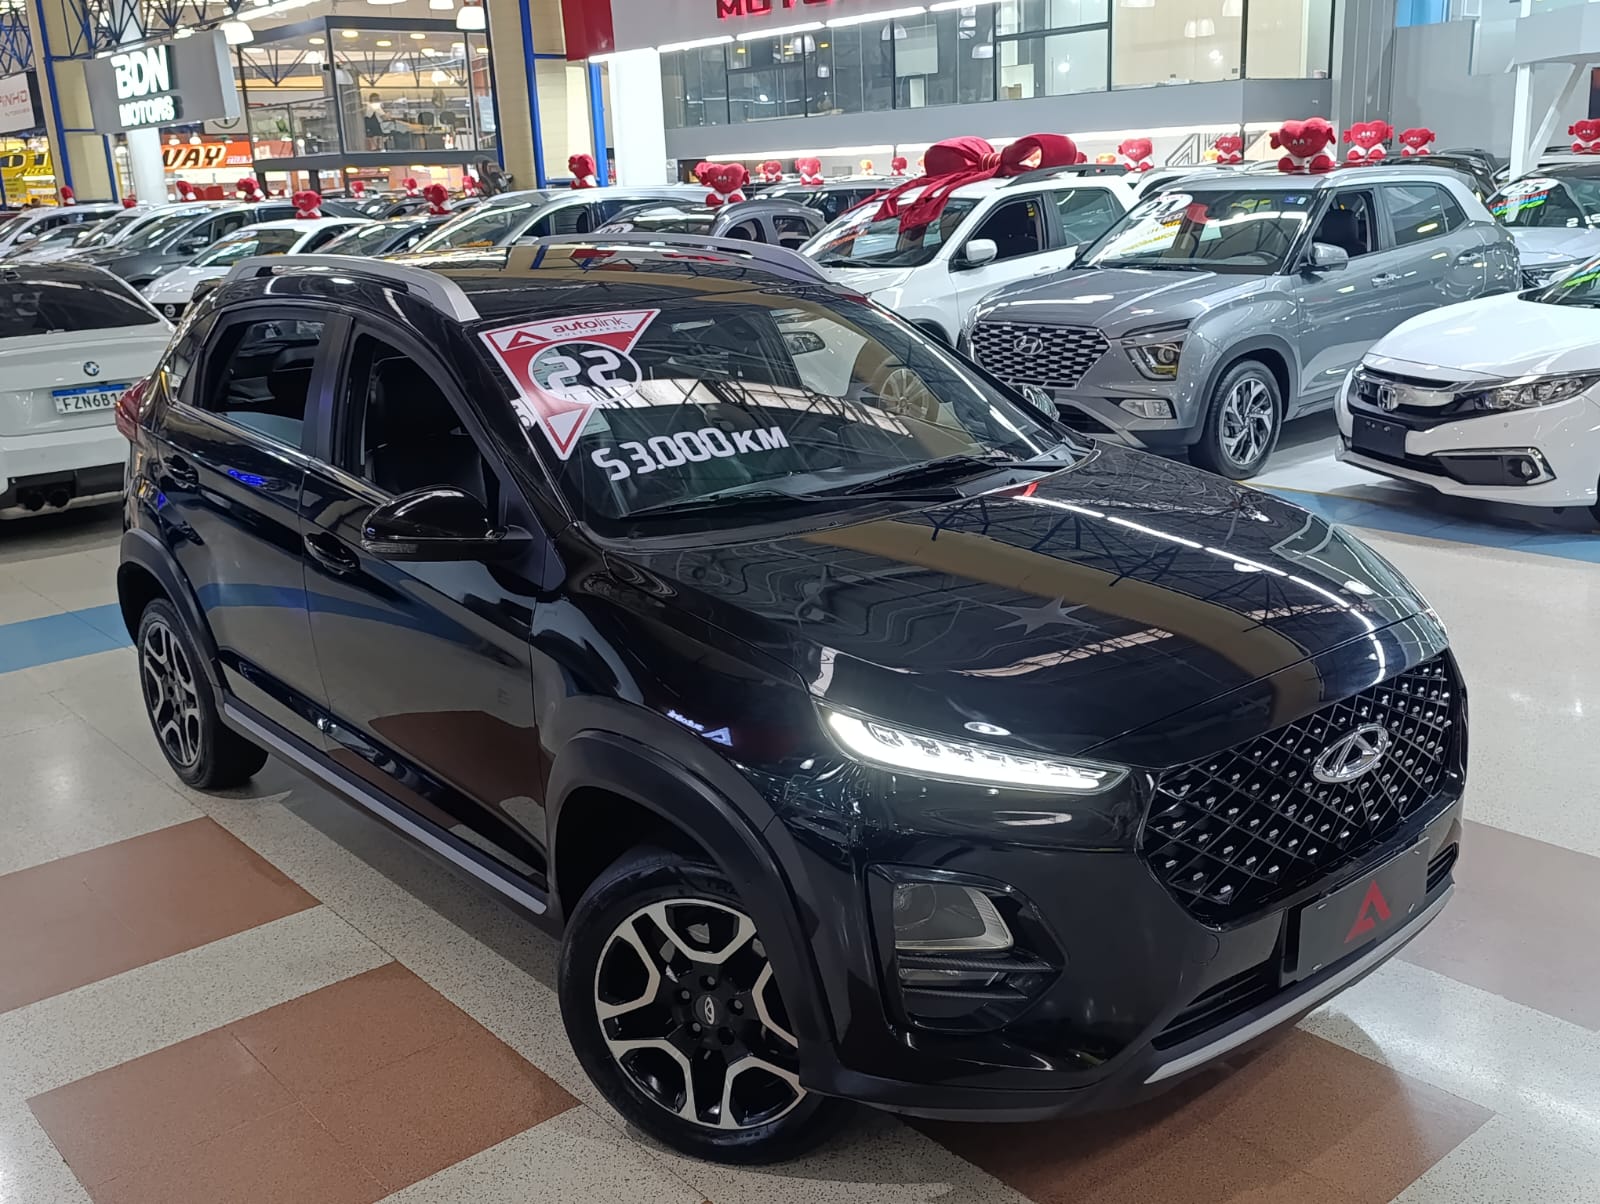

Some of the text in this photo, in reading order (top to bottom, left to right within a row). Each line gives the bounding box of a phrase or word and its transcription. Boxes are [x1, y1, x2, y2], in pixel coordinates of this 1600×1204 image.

[110, 45, 169, 99] BDN
[119, 96, 175, 127] MOTORS
[552, 317, 628, 333] autolink
[540, 349, 635, 396] 22
[62, 391, 124, 411] FZN6B1
